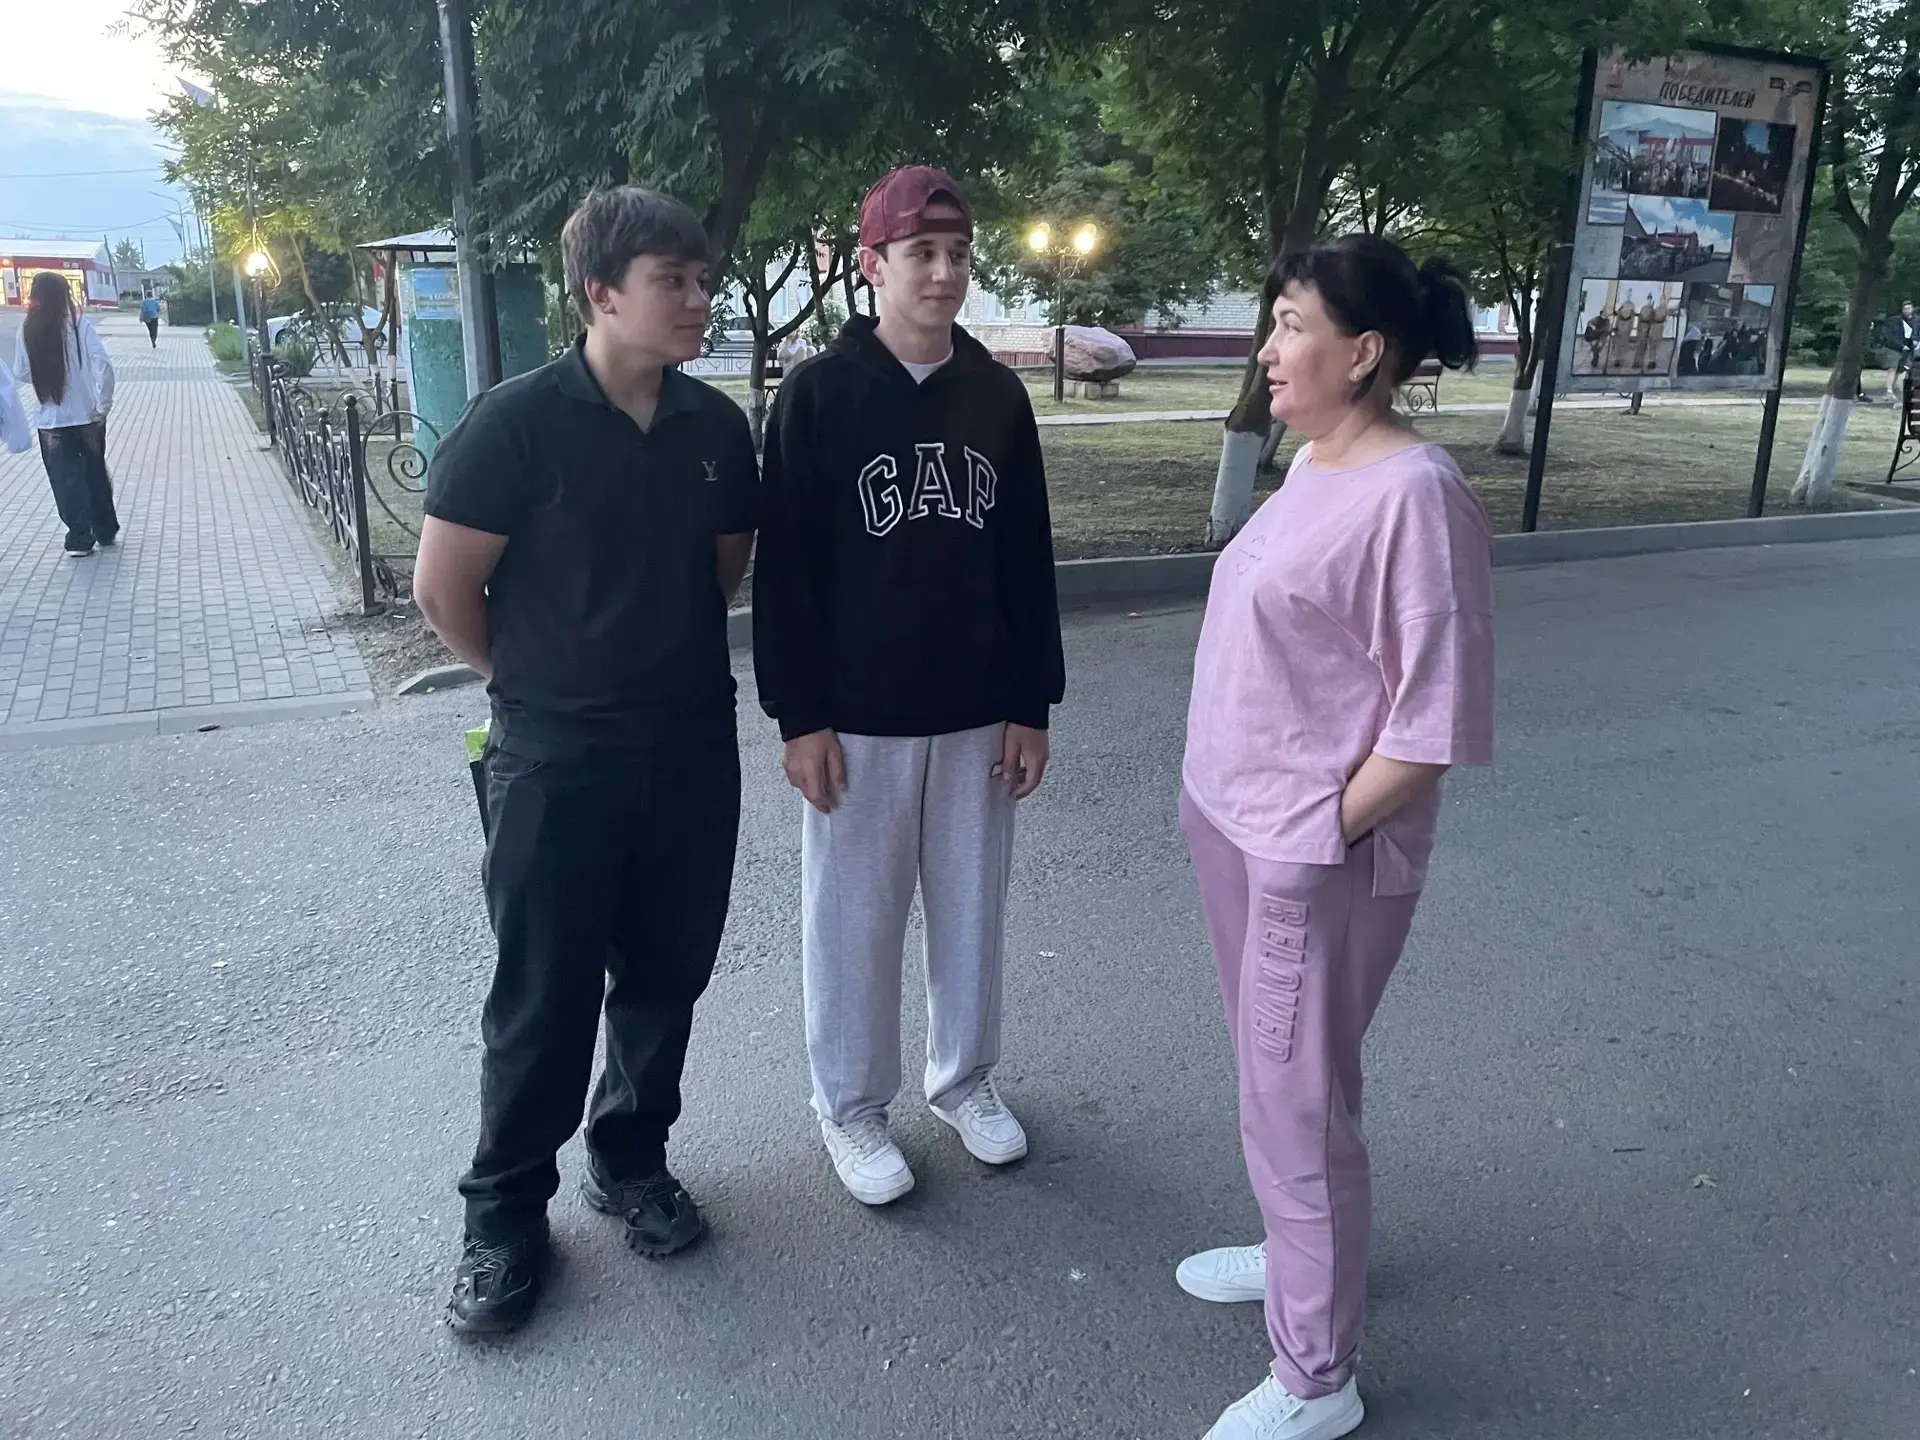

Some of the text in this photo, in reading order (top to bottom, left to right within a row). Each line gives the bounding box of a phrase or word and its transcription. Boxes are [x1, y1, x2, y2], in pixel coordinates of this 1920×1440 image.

[1659, 81, 1756, 109] ПОБЕДИТЕЛЕЙ
[858, 443, 998, 537] GAP
[1252, 893, 1310, 1065] BELOVED
